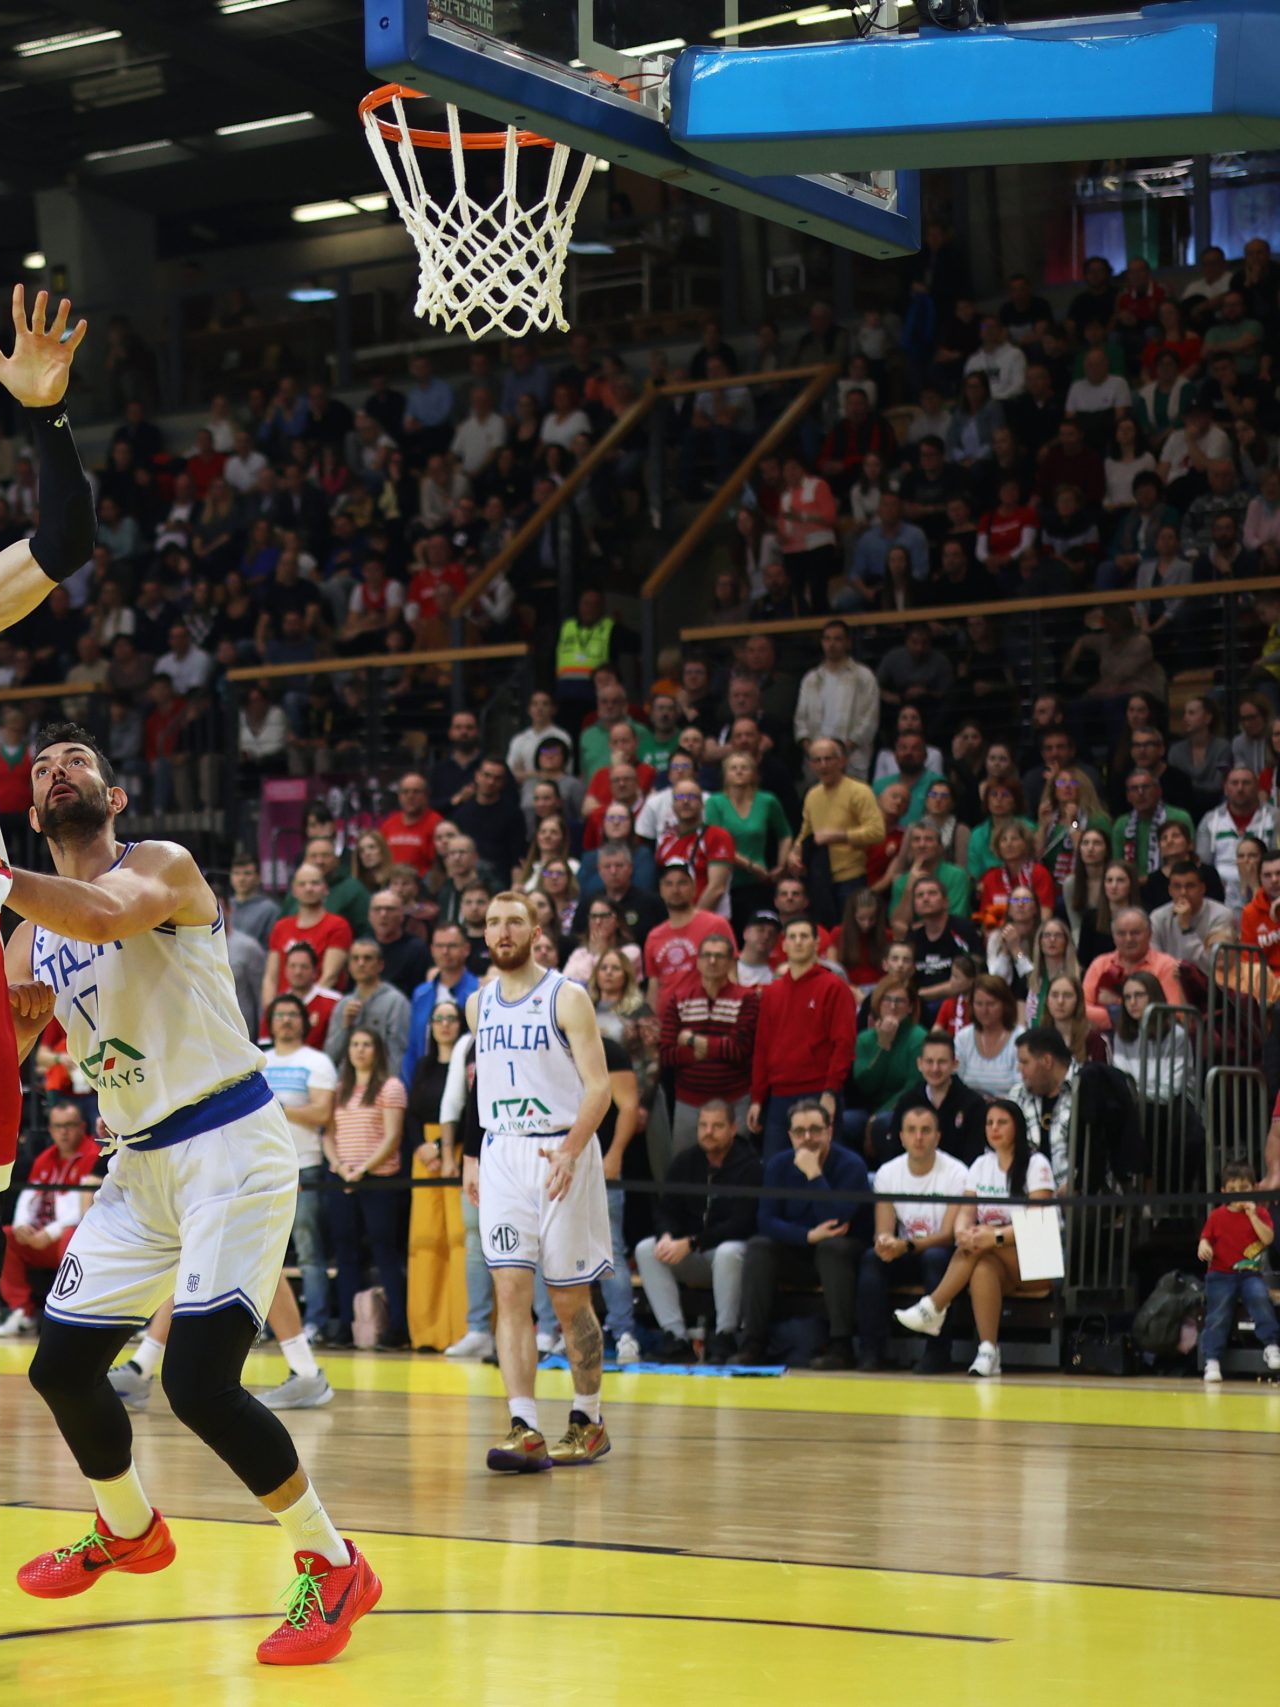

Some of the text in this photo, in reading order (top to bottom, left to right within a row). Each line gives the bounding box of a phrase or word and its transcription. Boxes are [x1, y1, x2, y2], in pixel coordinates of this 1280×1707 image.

[72, 983, 99, 1031] 17
[478, 1024, 550, 1053] ITALIA
[98, 1067, 145, 1089] WAYS
[507, 1061, 516, 1087] 1
[492, 1097, 552, 1119] ITA
[491, 1226, 519, 1253] MG
